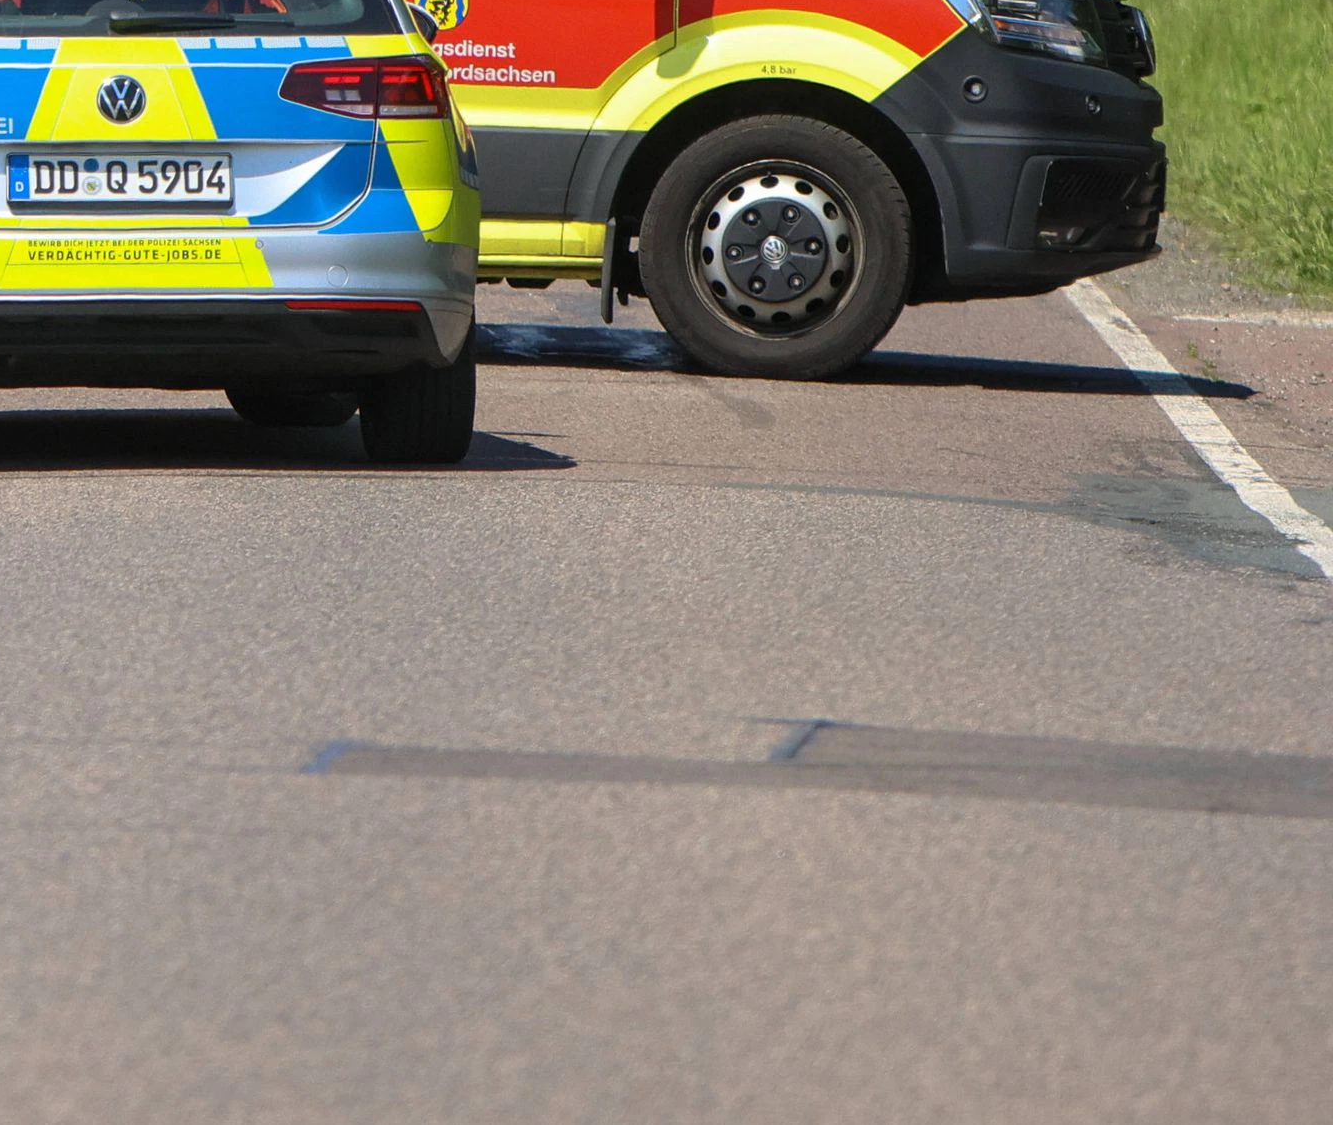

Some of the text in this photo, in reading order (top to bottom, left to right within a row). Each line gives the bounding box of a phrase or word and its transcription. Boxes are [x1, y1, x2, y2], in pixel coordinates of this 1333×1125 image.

[432, 40, 516, 59] gsdienst
[446, 64, 556, 83] ordsachsen
[761, 65, 797, 75] 4,8 bar
[15, 160, 226, 194] D DD Q 5904
[28, 239, 62, 247] BEWIRB
[64, 239, 83, 247] DICH
[86, 239, 109, 248] JETZT
[112, 239, 126, 247] BEI
[147, 238, 180, 246] POLIZEI
[183, 237, 221, 246] SACHSEN
[28, 248, 221, 263] VERDÄCHTIG-GUTE-JOBS.DE
